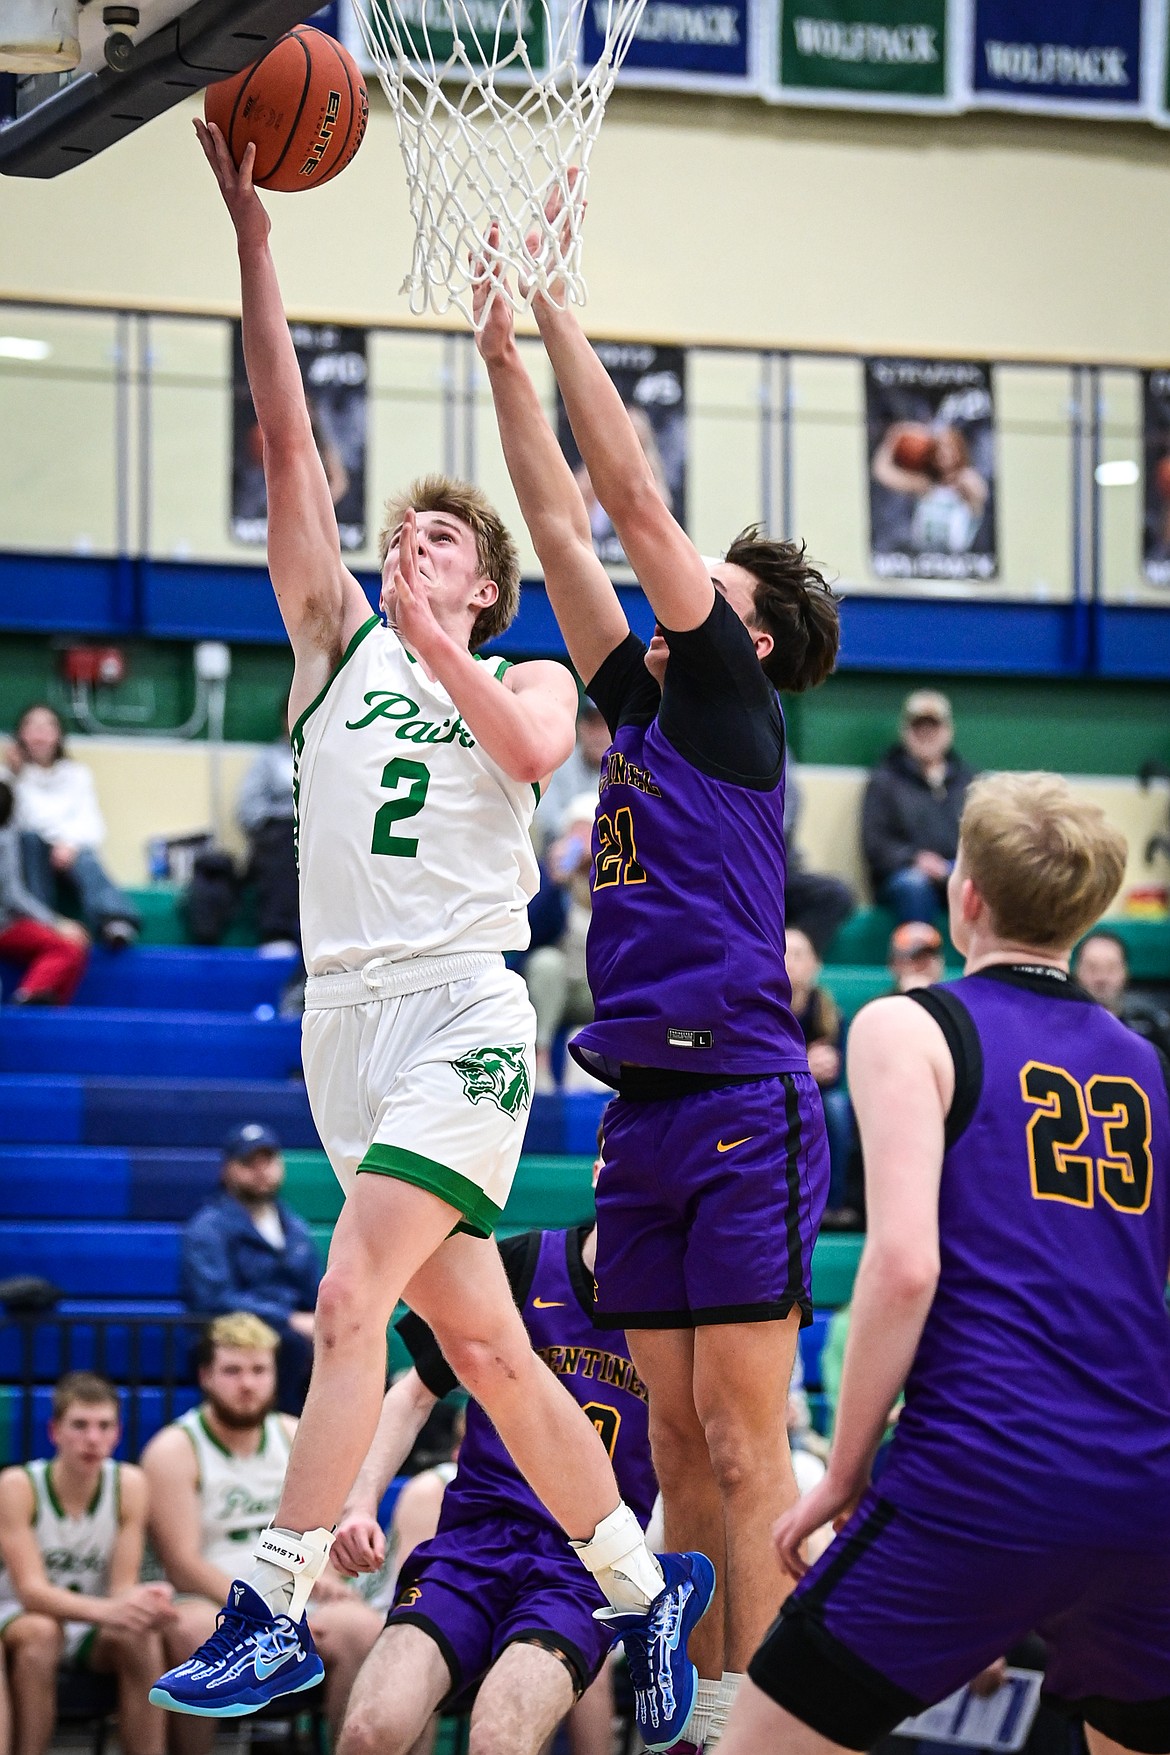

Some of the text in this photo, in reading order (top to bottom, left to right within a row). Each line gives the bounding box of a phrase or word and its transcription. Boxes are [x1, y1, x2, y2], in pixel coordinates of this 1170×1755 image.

[794, 20, 940, 64] WOLFPACK
[984, 40, 1130, 87] WOLFPACK
[299, 90, 342, 177] ELITE
[370, 757, 431, 858] 2
[592, 806, 647, 892] 21
[699, 1036, 706, 1045] L
[1019, 1060, 1153, 1215] 23
